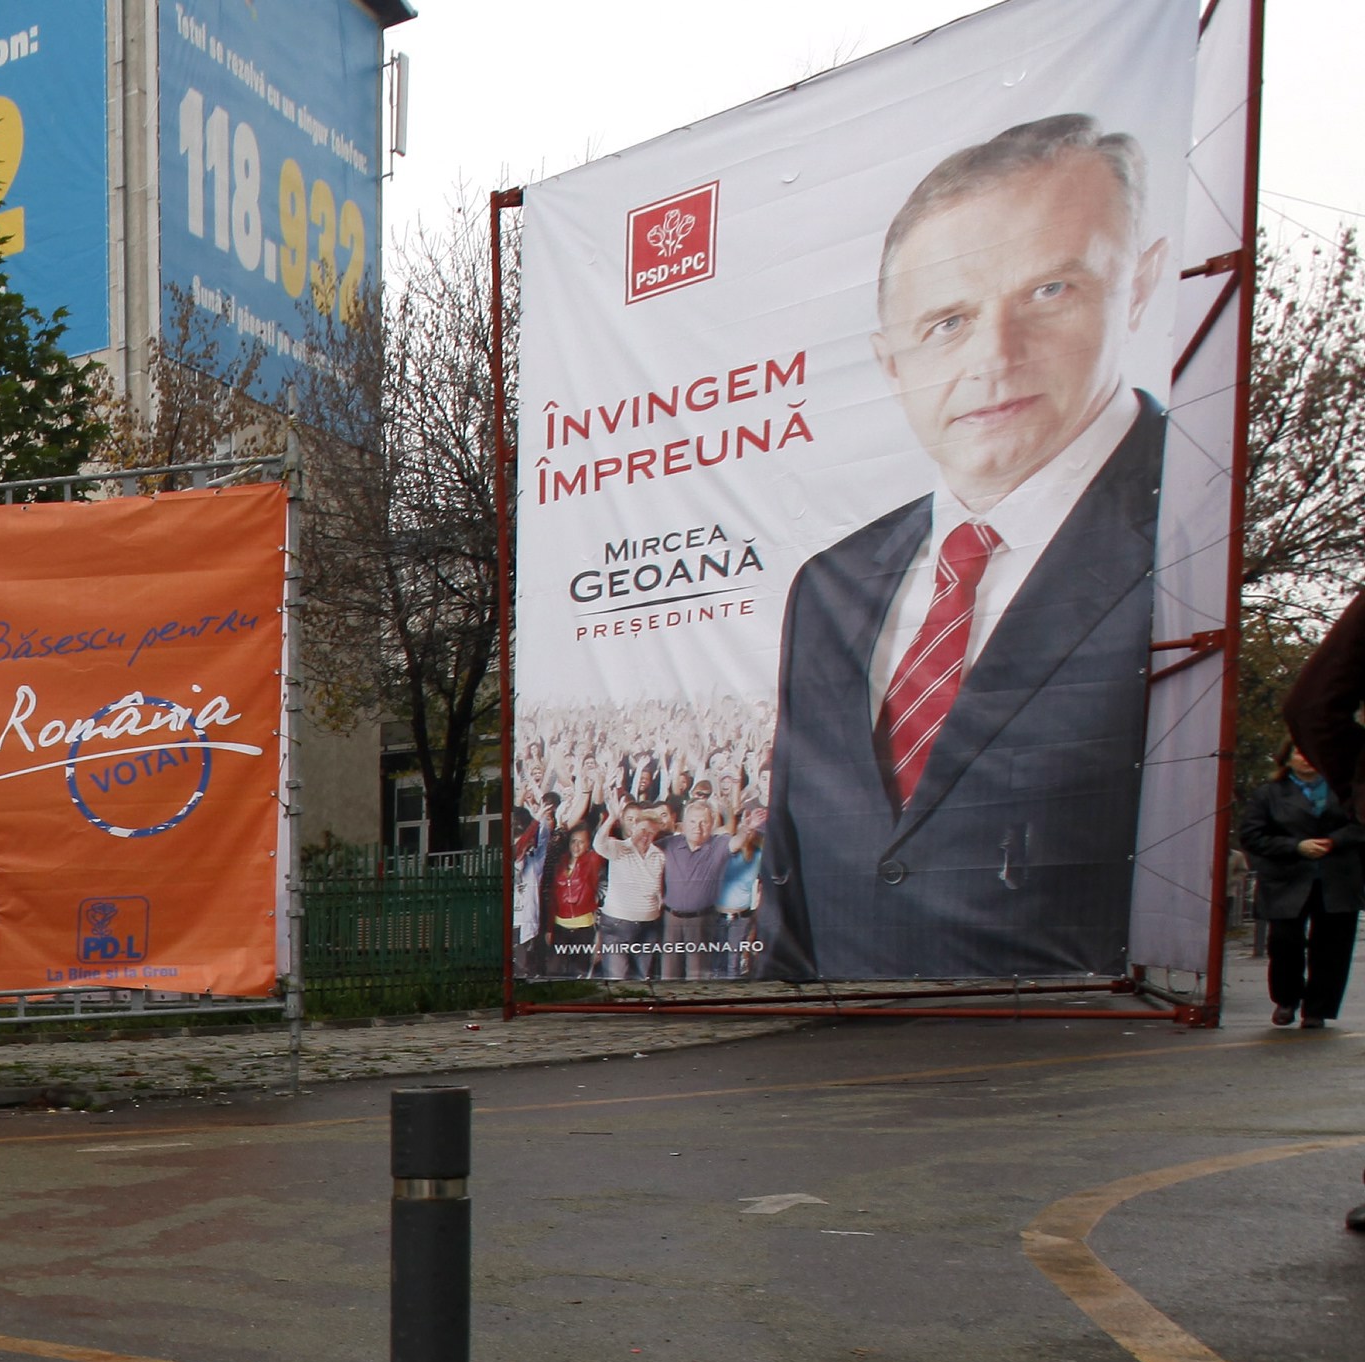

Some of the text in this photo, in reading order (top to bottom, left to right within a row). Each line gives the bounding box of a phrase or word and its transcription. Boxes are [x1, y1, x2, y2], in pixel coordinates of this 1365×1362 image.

[179, 86, 366, 332] 118.932
[635, 251, 707, 291] PSD+PC
[542, 349, 807, 451] ÎNVINGEM
[534, 398, 815, 506] ÎMPREUNĂ
[604, 523, 728, 566] MIRCEA
[568, 536, 764, 604] GEOANĂ
[575, 598, 755, 642] PREȘEDINTE
[90, 737, 191, 794] VOTAT
[83, 935, 142, 960] PD-L
[554, 939, 765, 956] WWW.MIRCEAGEOANA.RO
[46, 968, 64, 982] La
[68, 966, 101, 981] Bine
[123, 965, 138, 979] la
